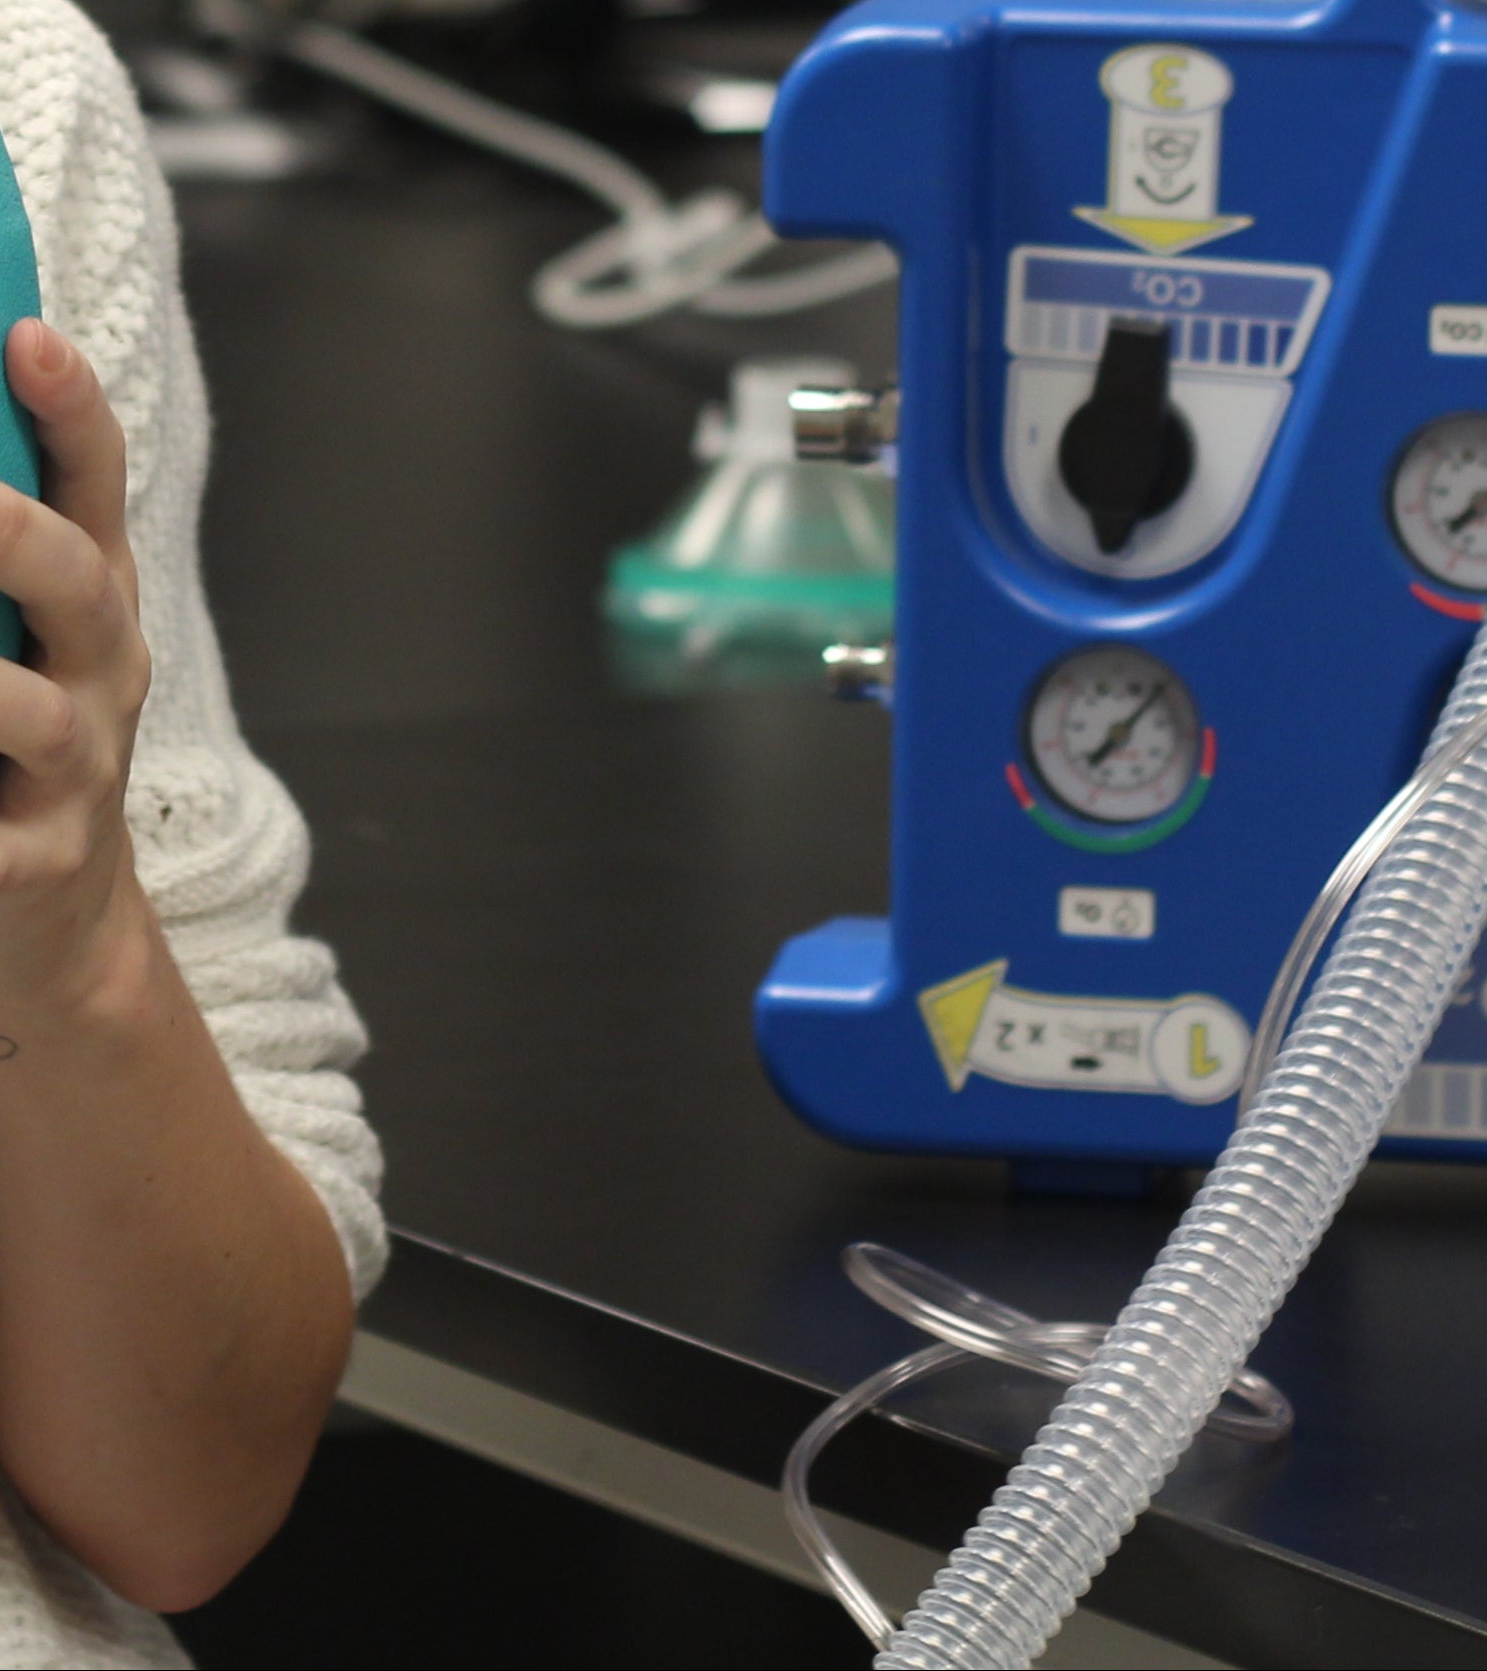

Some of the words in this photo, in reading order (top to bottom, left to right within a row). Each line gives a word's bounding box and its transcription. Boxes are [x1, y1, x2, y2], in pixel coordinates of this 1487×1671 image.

[1149, 55, 1188, 108] 3
[995, 1021, 1016, 1053] 2
[1188, 1021, 1221, 1080] 1
